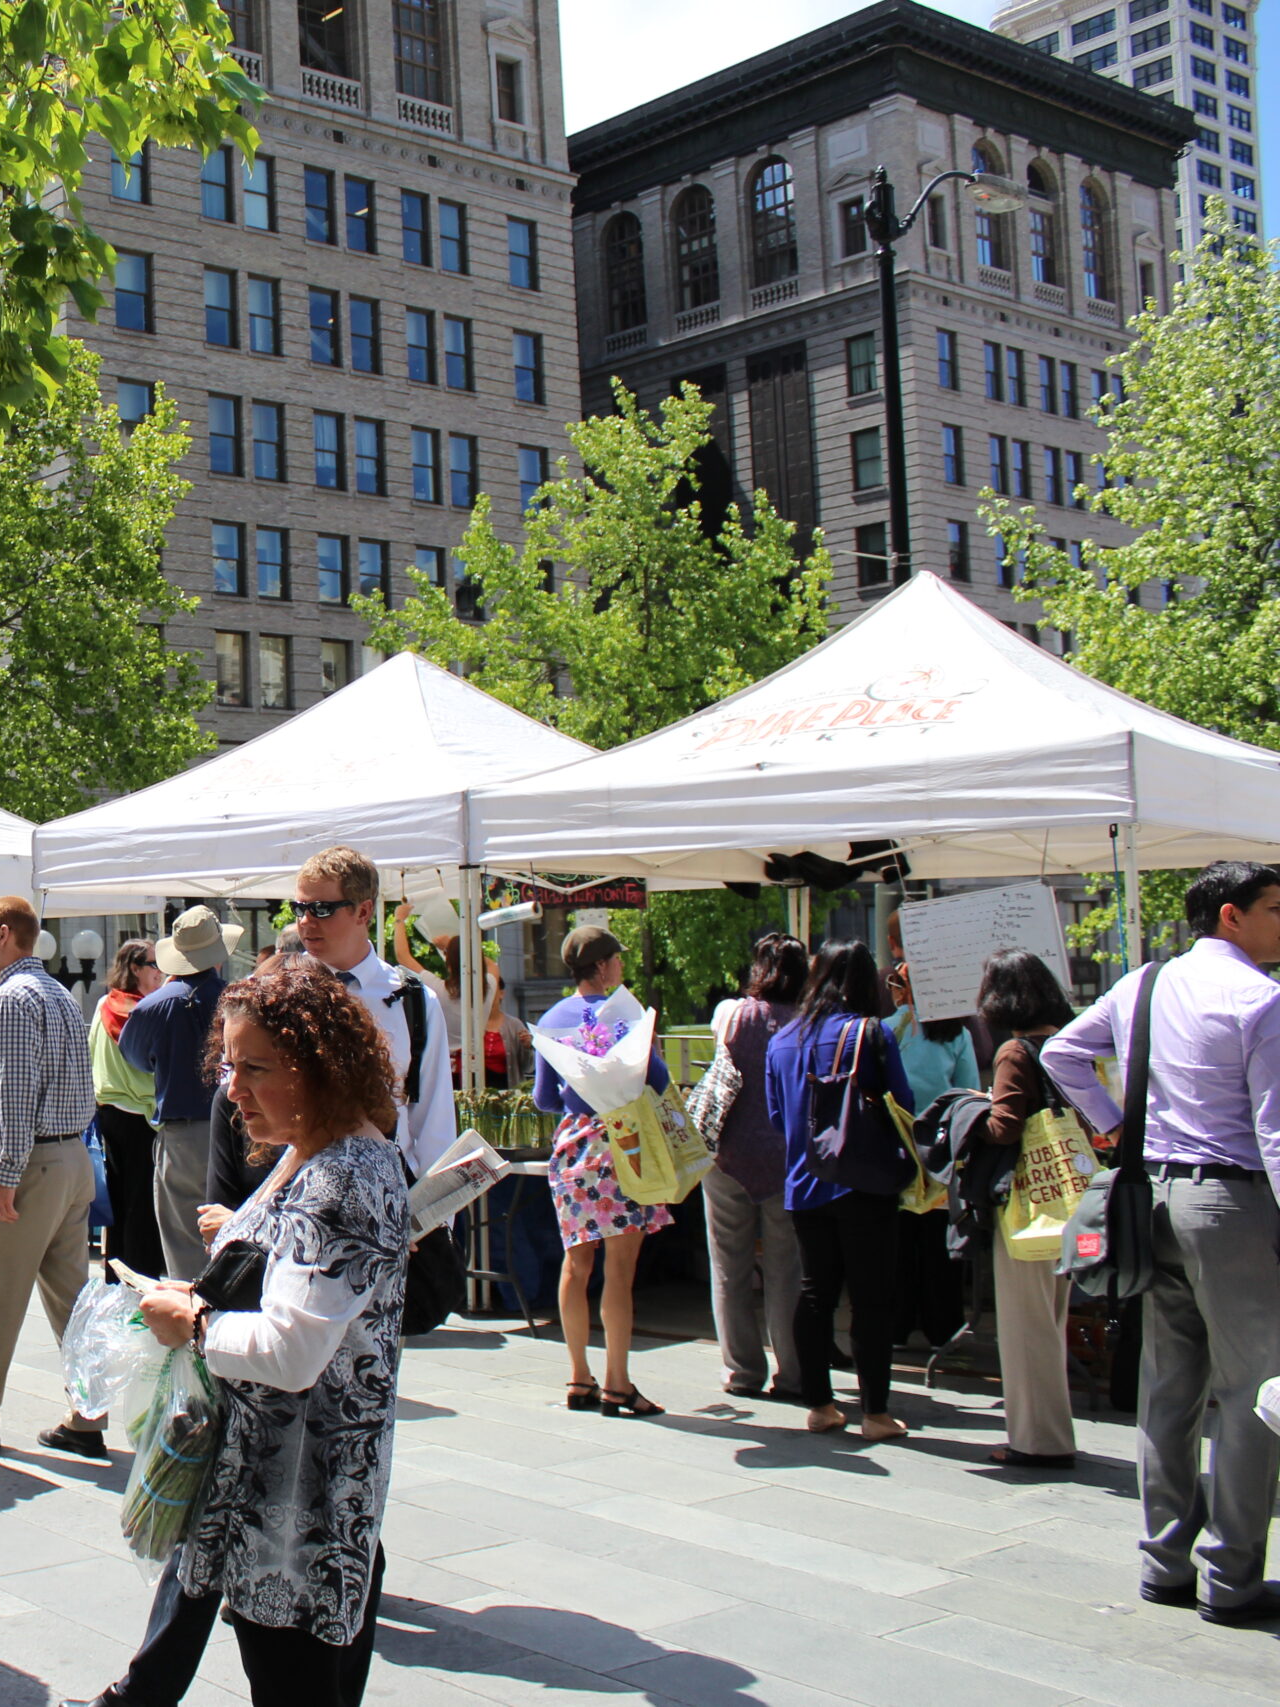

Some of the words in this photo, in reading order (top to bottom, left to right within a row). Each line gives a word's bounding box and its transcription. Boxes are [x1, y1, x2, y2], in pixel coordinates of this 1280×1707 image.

[694, 702, 837, 751] PIKE
[827, 699, 963, 728] PLACE
[1022, 1138, 1079, 1168] PUBLIC
[1014, 1158, 1074, 1191] MARKET
[1028, 1175, 1090, 1205] CENTER
